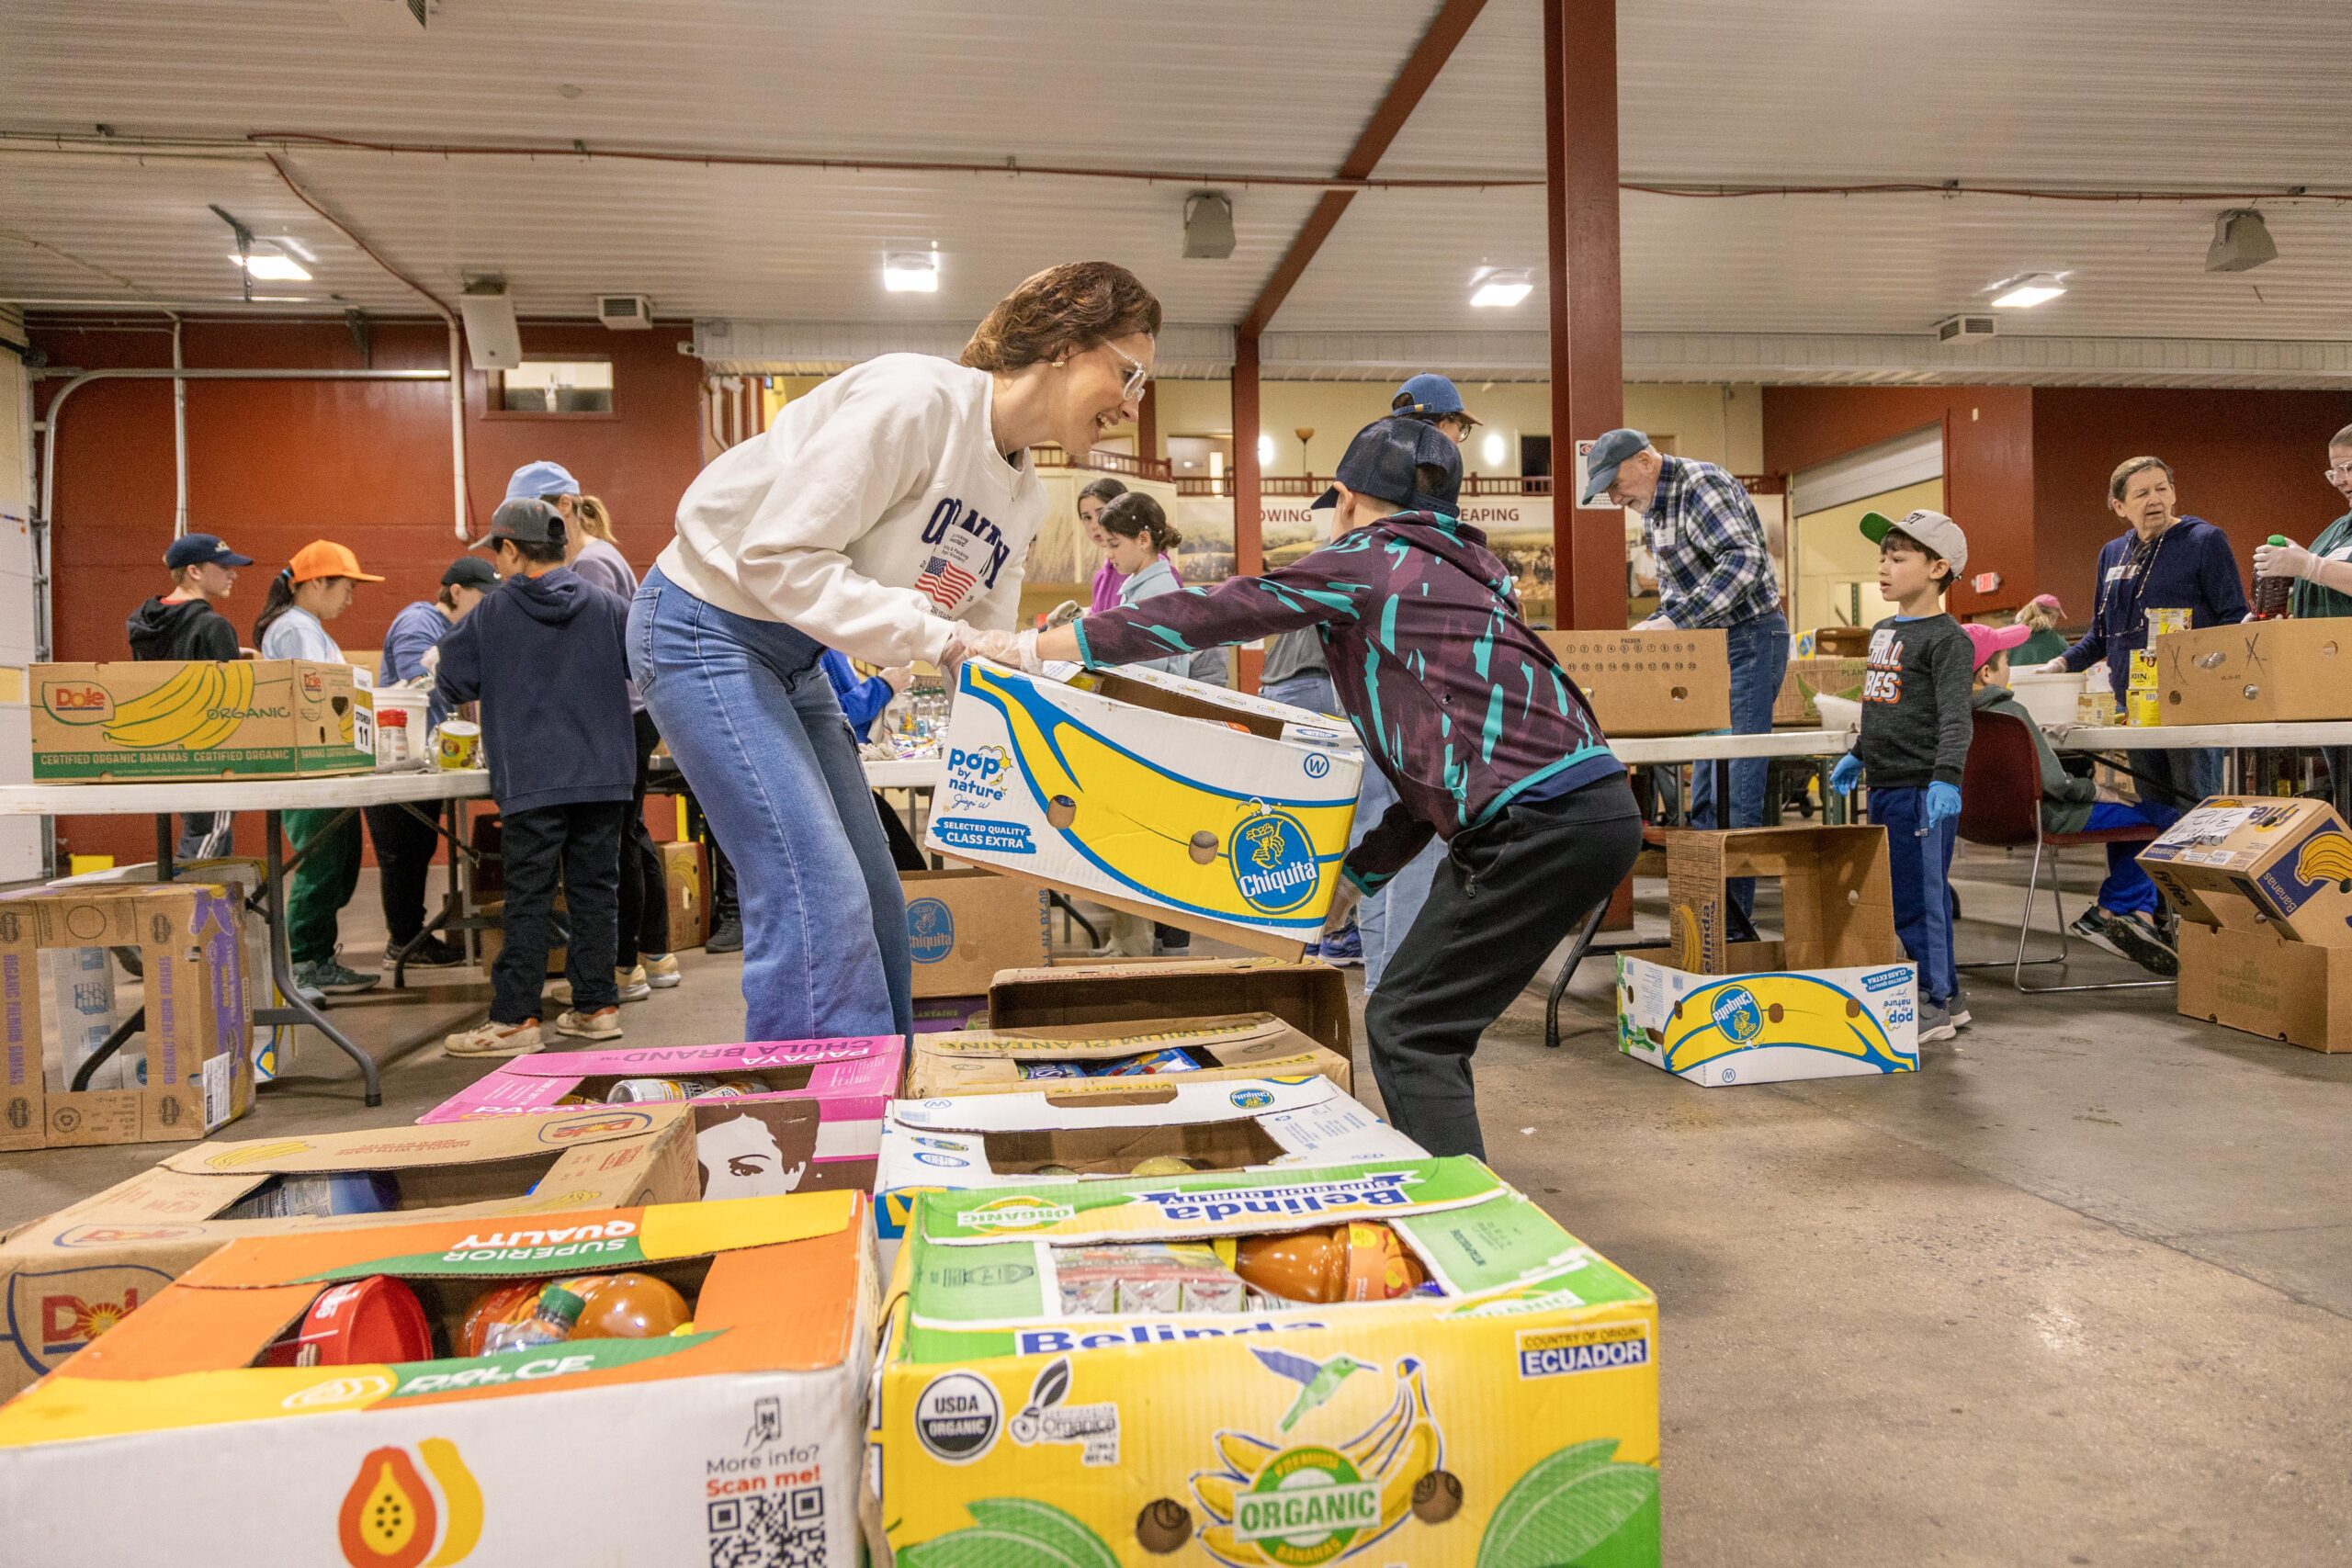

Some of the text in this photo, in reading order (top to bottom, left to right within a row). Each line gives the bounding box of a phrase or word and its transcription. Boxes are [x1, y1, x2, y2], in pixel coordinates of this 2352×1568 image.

[56, 687, 106, 708] Dole
[207, 707, 290, 720] ORGANIC
[358, 726, 368, 747] 11
[40, 750, 289, 764] CERTIFIED ORGANIC BANANAS CERTIFIED ORGANIC
[947, 748, 1001, 780] pop
[957, 767, 971, 780] by
[948, 778, 1003, 801] nature
[944, 821, 1026, 836] SELECTED QUALITY
[946, 832, 1024, 849] CLASS EXTRA
[1239, 861, 1317, 898] Chiquita
[2264, 872, 2298, 913] Bananas
[159, 956, 173, 995] BANANAS
[1868, 969, 1906, 984] CLASS EXTRA
[1713, 990, 1755, 1023] Chiquita
[1889, 1008, 1913, 1023] pop
[739, 1039, 873, 1055] CHULA
[938, 1021, 1259, 1052] PREMIUM PLANTAINS
[163, 1041, 176, 1084] ORGANIC
[741, 1046, 871, 1066] PAPAYA
[1231, 1089, 1274, 1101] Chiquita
[552, 1119, 633, 1139] Dole
[413, 1142, 469, 1151] HANDLE
[961, 1206, 1069, 1223] ORGANIC
[1164, 1189, 1406, 1222] Belinda
[81, 1228, 188, 1241] Dole
[451, 1220, 636, 1250] QUALITY
[443, 1238, 627, 1262] SUPERIOR
[1523, 1333, 1581, 1348] COUNTRY
[1582, 1331, 1597, 1342] OF
[1523, 1340, 1645, 1376] ECUADOR
[934, 1394, 979, 1414] USDA
[928, 1417, 987, 1438] ORGANIC
[707, 1444, 820, 1475] More info?
[1274, 1451, 1340, 1478] PREMIUM
[707, 1463, 820, 1497] Scan me!
[1240, 1489, 1376, 1533] ORGANIC
[1275, 1537, 1342, 1562] BANANAS
